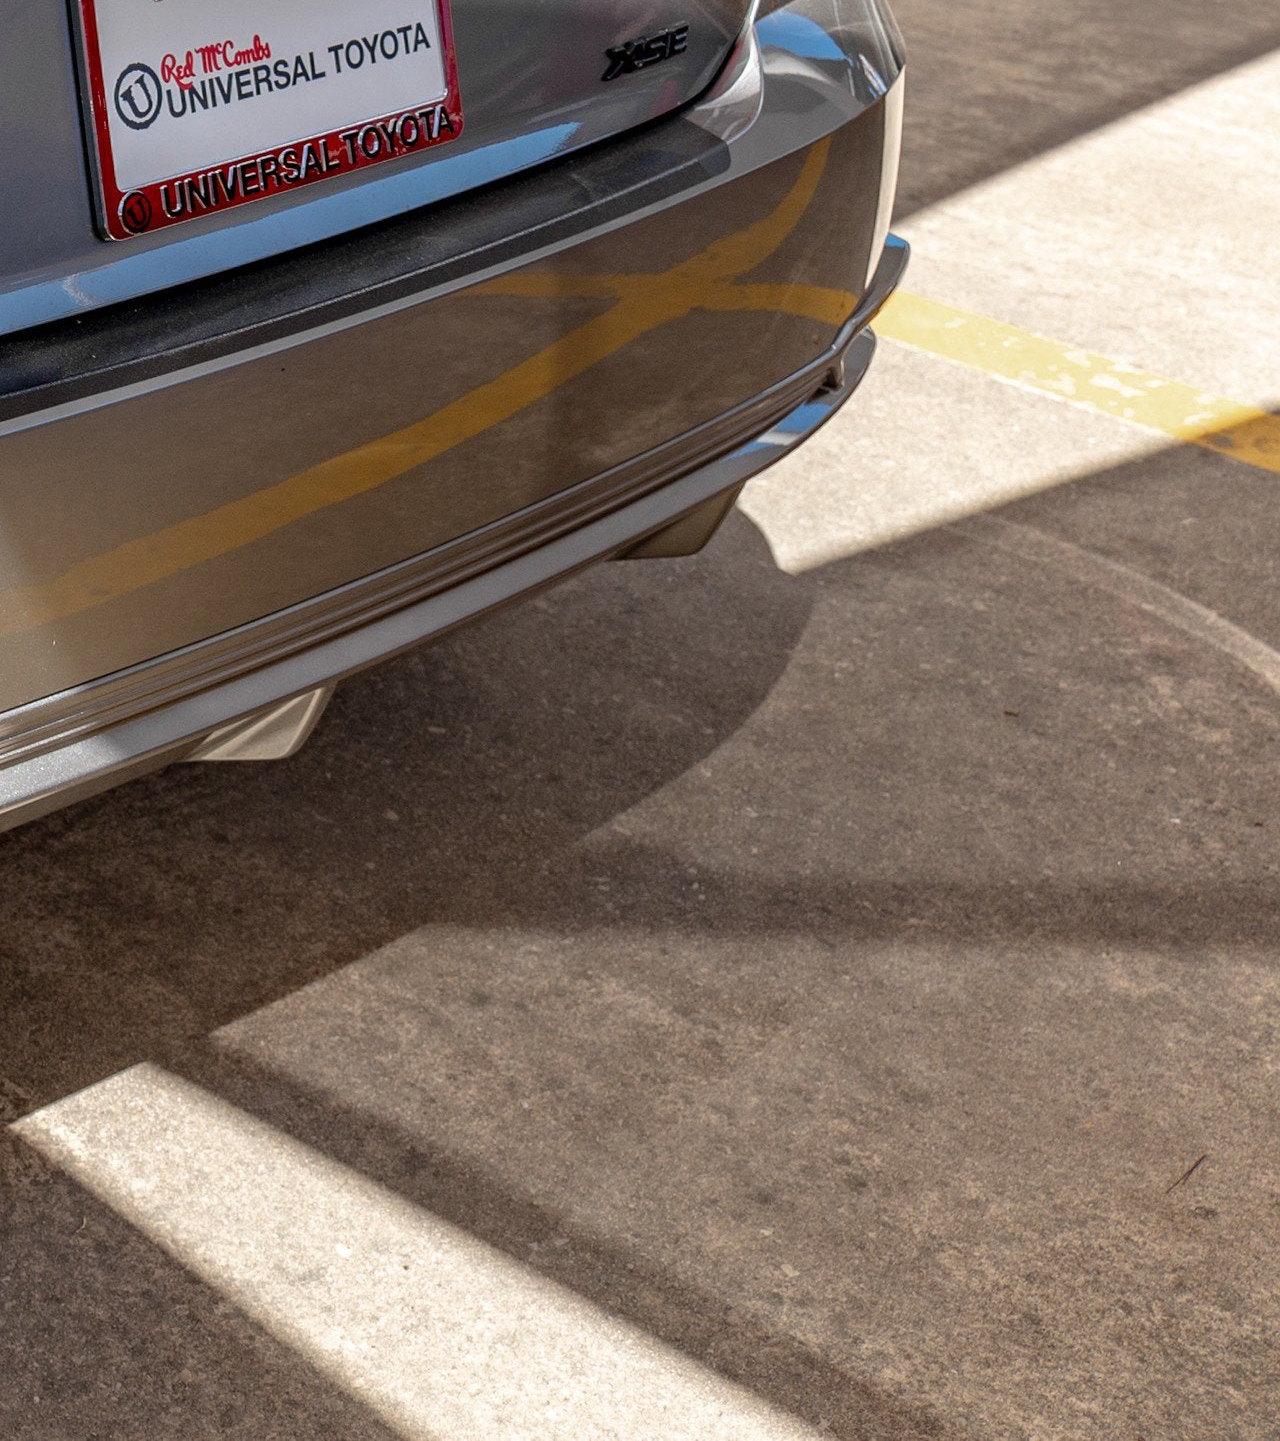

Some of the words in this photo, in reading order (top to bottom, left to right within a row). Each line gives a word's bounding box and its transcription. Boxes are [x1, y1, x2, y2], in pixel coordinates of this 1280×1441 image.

[161, 51, 193, 90] Red
[195, 34, 271, 74] McCombs
[166, 52, 326, 118] UNIVERSAL
[327, 22, 430, 74] TOYOTA
[601, 24, 689, 81] XSE
[159, 139, 340, 218] UNIVERSAL
[340, 105, 454, 164] TOYOTA
